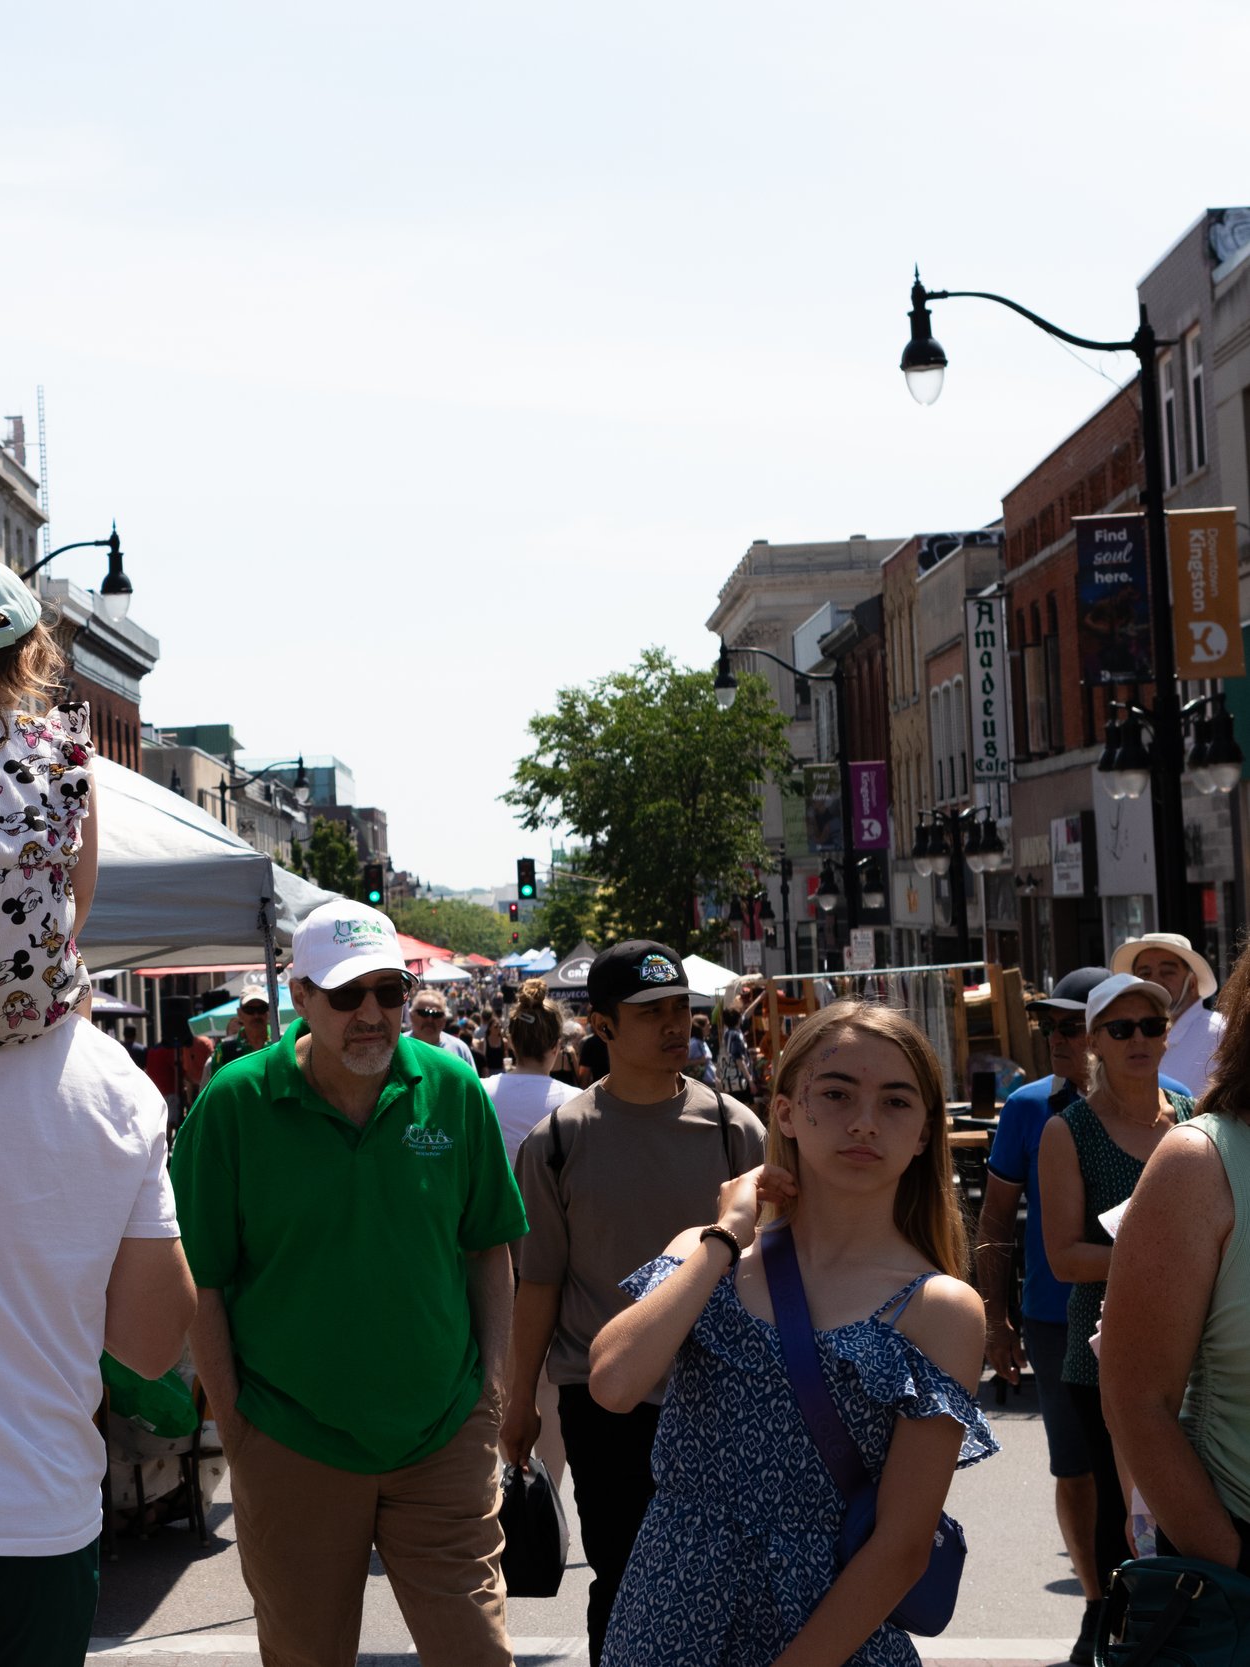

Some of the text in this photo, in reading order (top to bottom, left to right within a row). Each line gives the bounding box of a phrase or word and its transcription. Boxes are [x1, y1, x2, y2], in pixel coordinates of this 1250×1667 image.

[1094, 528, 1128, 543] Find
[1093, 542, 1134, 565] soul
[1188, 529, 1206, 612] Kingston
[1207, 528, 1219, 598] Downtown
[1094, 571, 1132, 584] here.
[973, 600, 998, 758] Amadeus
[975, 758, 1008, 773] Cafe
[568, 969, 590, 978] CRA
[642, 964, 678, 978] EAGLES
